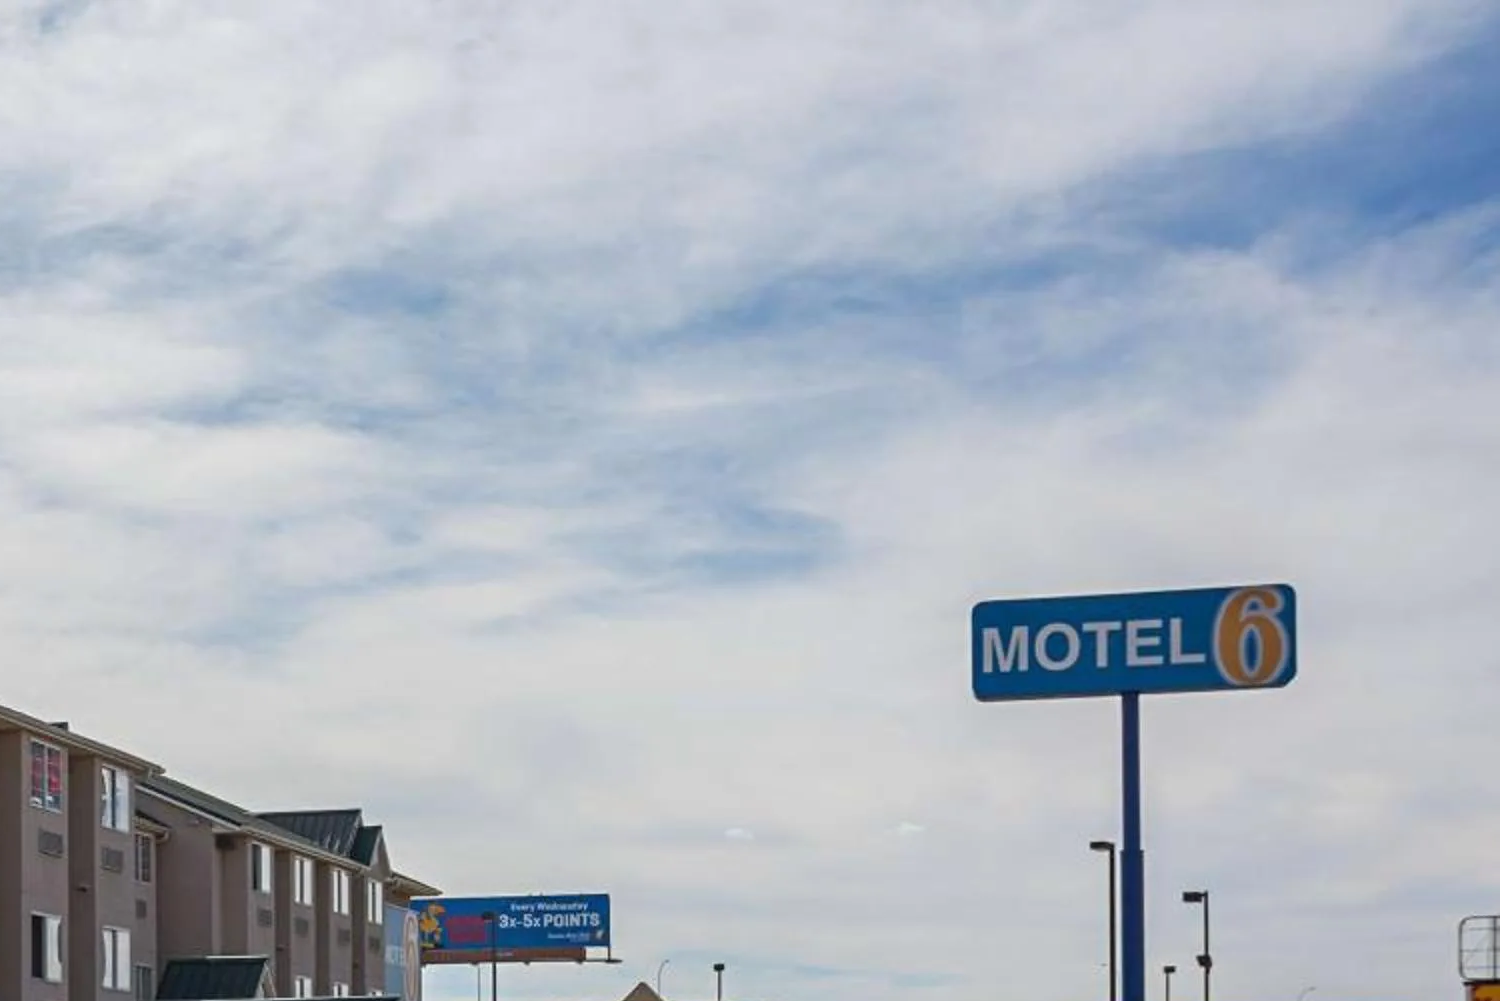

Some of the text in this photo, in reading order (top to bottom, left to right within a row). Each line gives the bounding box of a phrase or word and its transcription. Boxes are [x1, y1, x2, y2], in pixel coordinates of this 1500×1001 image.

[982, 586, 1289, 687] MOTEL 6
[499, 912, 600, 928] 3x-5x POINTS
